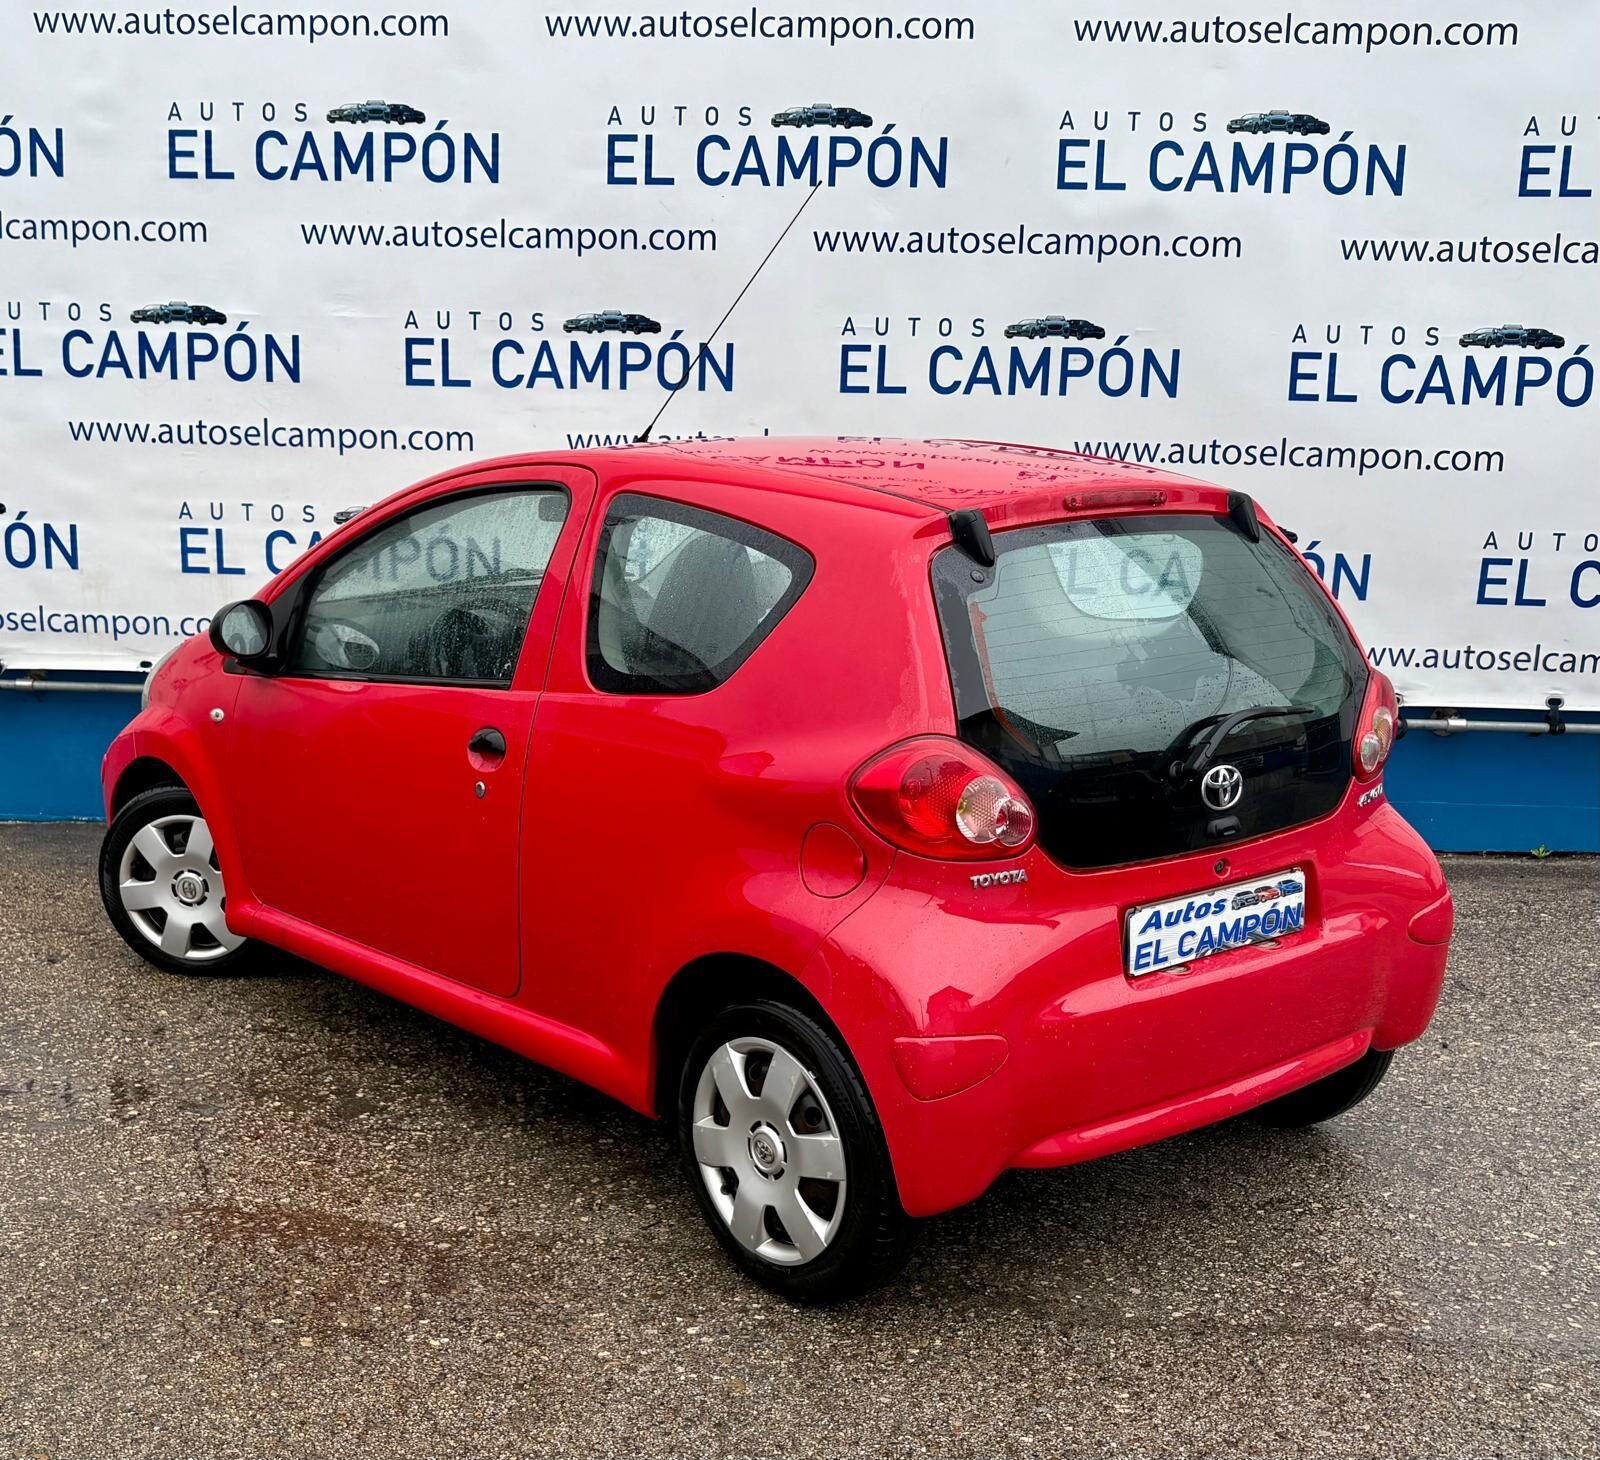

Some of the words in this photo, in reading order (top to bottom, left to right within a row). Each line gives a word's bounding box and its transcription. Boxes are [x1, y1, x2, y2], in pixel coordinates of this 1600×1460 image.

[34, 6, 448, 43] www.autoselcampon.com
[546, 7, 974, 46] www.autoselcampon.com
[1074, 13, 1518, 53] www.autoselcampon.com
[168, 102, 307, 122] AUTOS
[608, 106, 751, 126] AUTOS
[1060, 111, 1207, 132] AUTOS
[1524, 115, 1600, 137] AU
[168, 129, 235, 180] EL
[255, 120, 500, 184] CAMPÓN
[606, 134, 675, 186] EL
[697, 124, 948, 188] CAMPÓN
[1056, 139, 1127, 191] EL
[1149, 131, 1407, 196] CAMPÓN
[1518, 145, 1592, 198] EL
[0, 210, 207, 247] lcampon.com
[301, 219, 717, 257] www.autoselcampon.com
[814, 225, 1242, 263] www.autoselcampon.com
[1341, 233, 1600, 264] www.autoselca
[8, 301, 112, 322] UTOS
[405, 311, 544, 331] AUTOS
[842, 317, 985, 338] AUTOS
[0, 328, 43, 376] L
[62, 322, 301, 383] CAMPÓN
[1292, 324, 1439, 345] AUTOS
[404, 338, 472, 388] EL
[492, 330, 734, 392] CAMPÓN
[840, 345, 907, 395] EL
[928, 336, 1181, 399] CAMPÓN
[1287, 352, 1358, 402] EL
[1380, 345, 1600, 407] CAMPÓ
[69, 418, 474, 455] www.autoselcampon.com
[1074, 438, 1504, 476] www.autoselcampon.com
[178, 501, 315, 523] AUTOS
[4, 510, 79, 570] ÓN
[180, 527, 246, 575] EL
[1483, 531, 1599, 552] AUTO
[1476, 557, 1547, 607] EL
[1367, 643, 1600, 674] ww.autoselcam
[969, 868, 1029, 889] TOYOTA
[1138, 897, 1228, 936] Autos
[1133, 939, 1169, 972] EL
[1177, 901, 1303, 958] CAMPÓN
